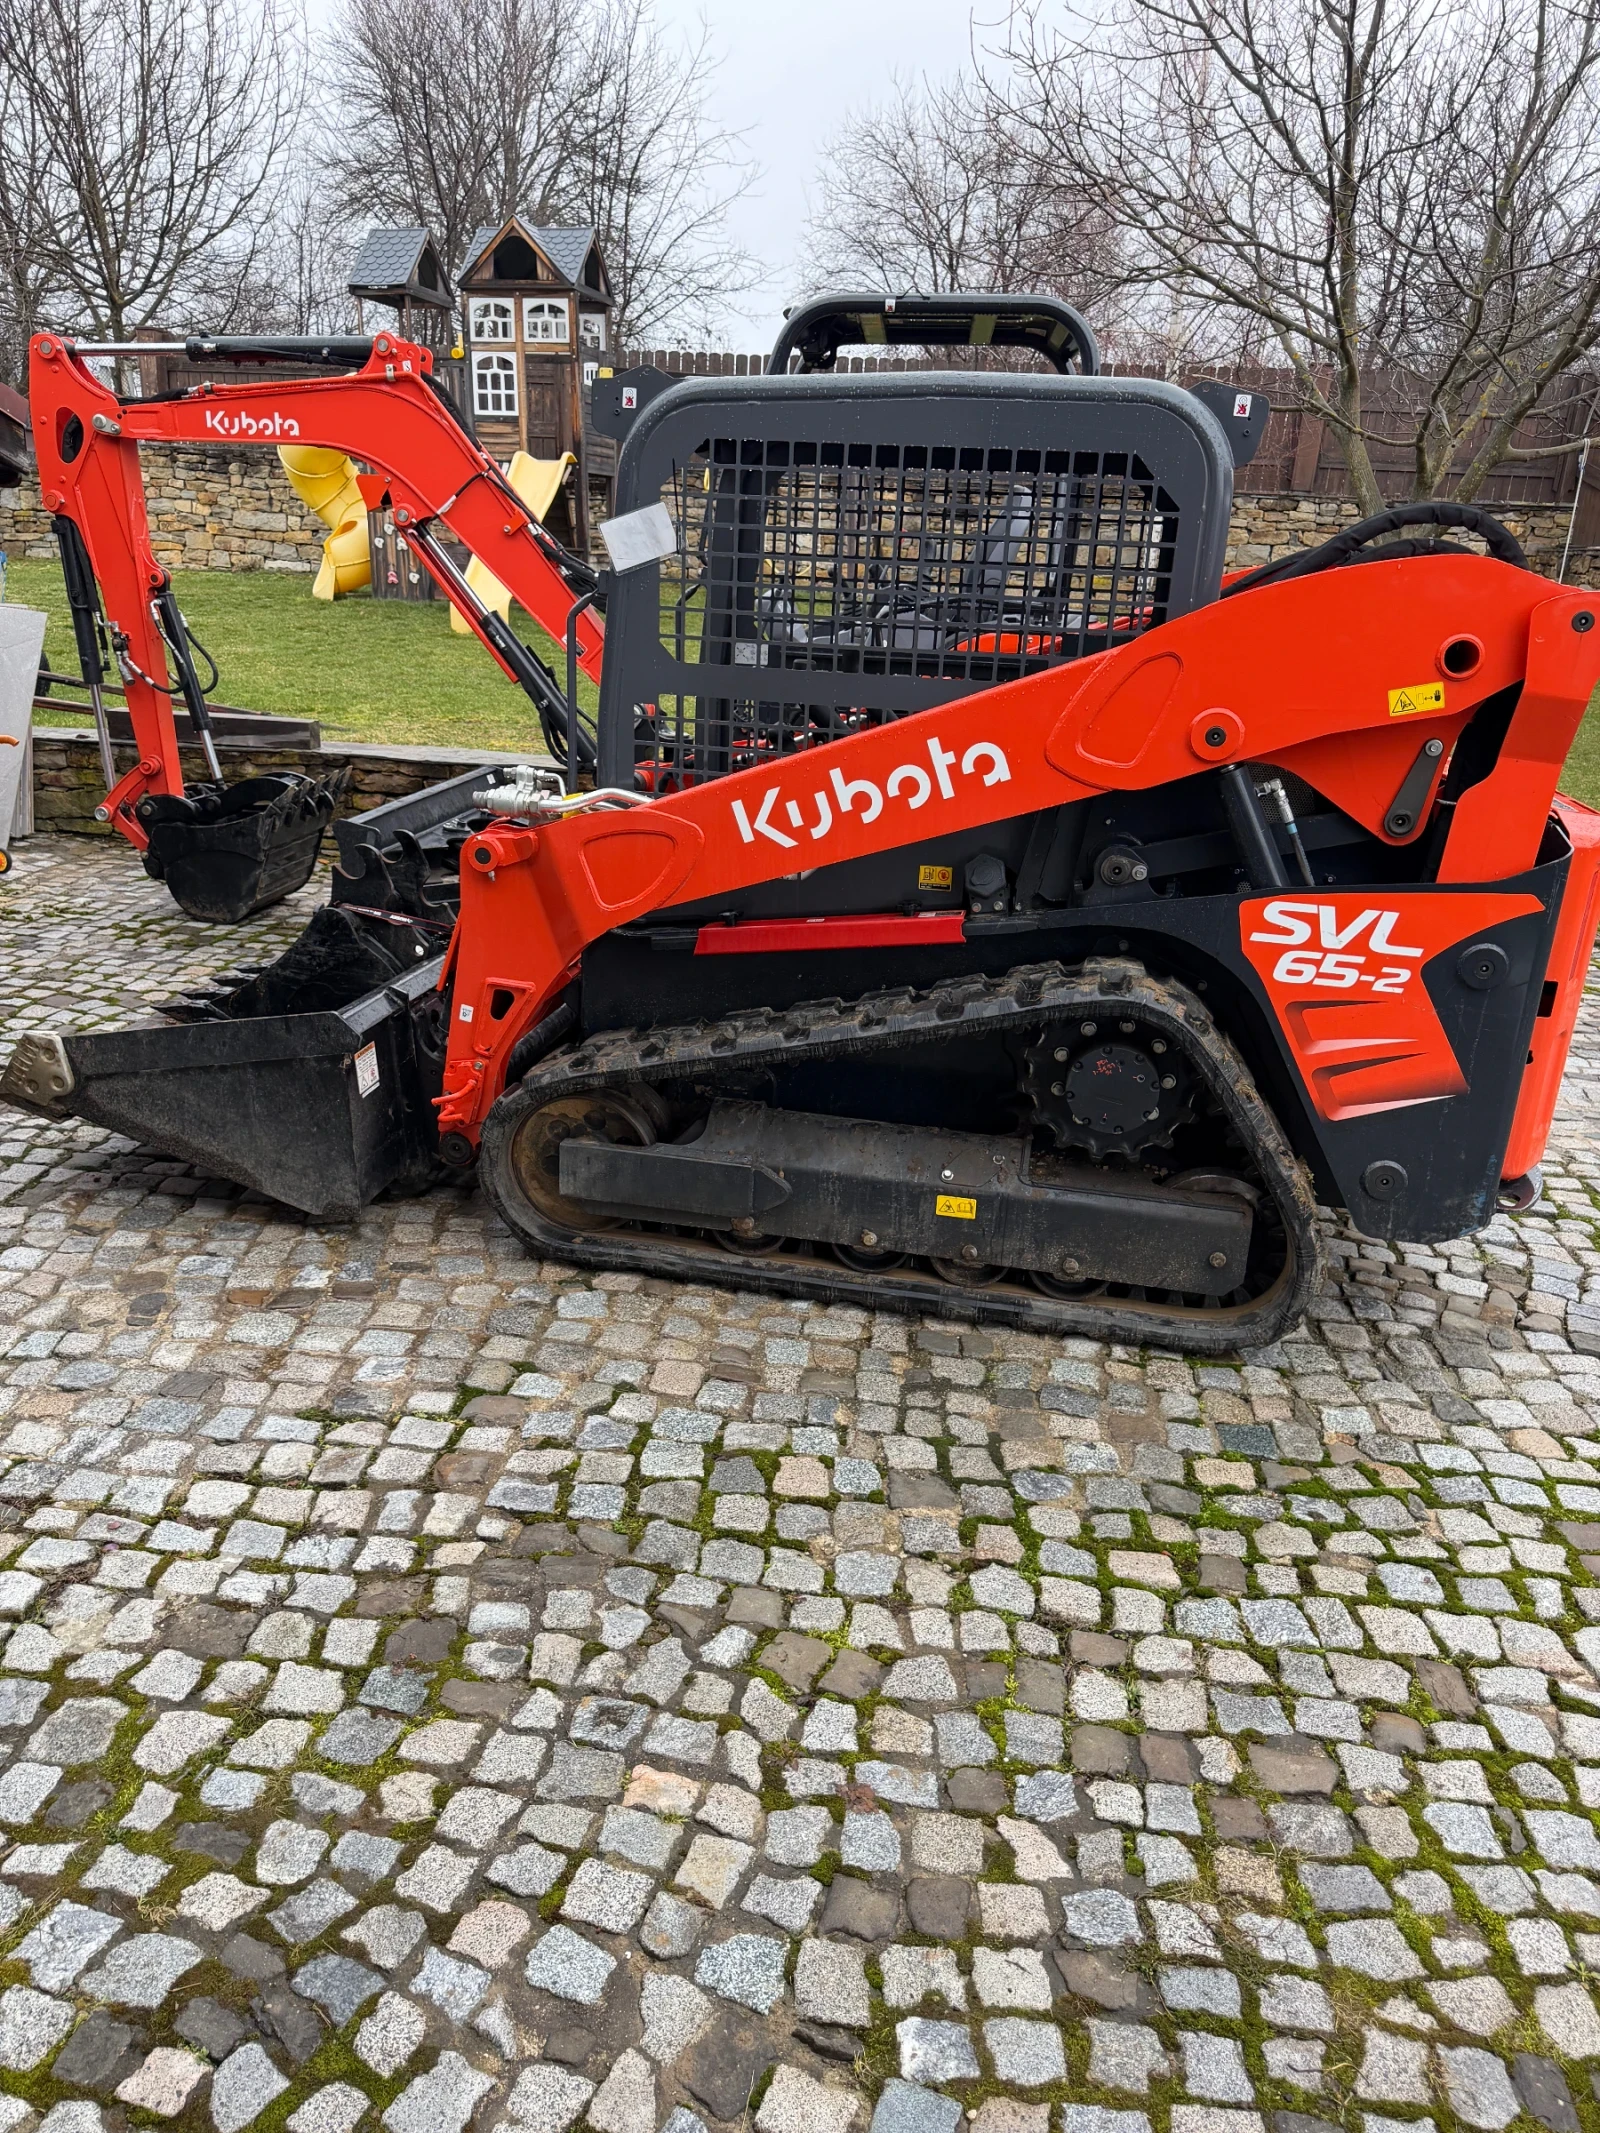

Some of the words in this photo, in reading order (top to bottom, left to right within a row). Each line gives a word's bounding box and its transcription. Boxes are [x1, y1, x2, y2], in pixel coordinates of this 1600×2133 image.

[205, 410, 300, 436] Kubota
[731, 736, 1012, 848] Kubota
[1249, 900, 1425, 958] SVL
[1272, 950, 1412, 994] 65-2
